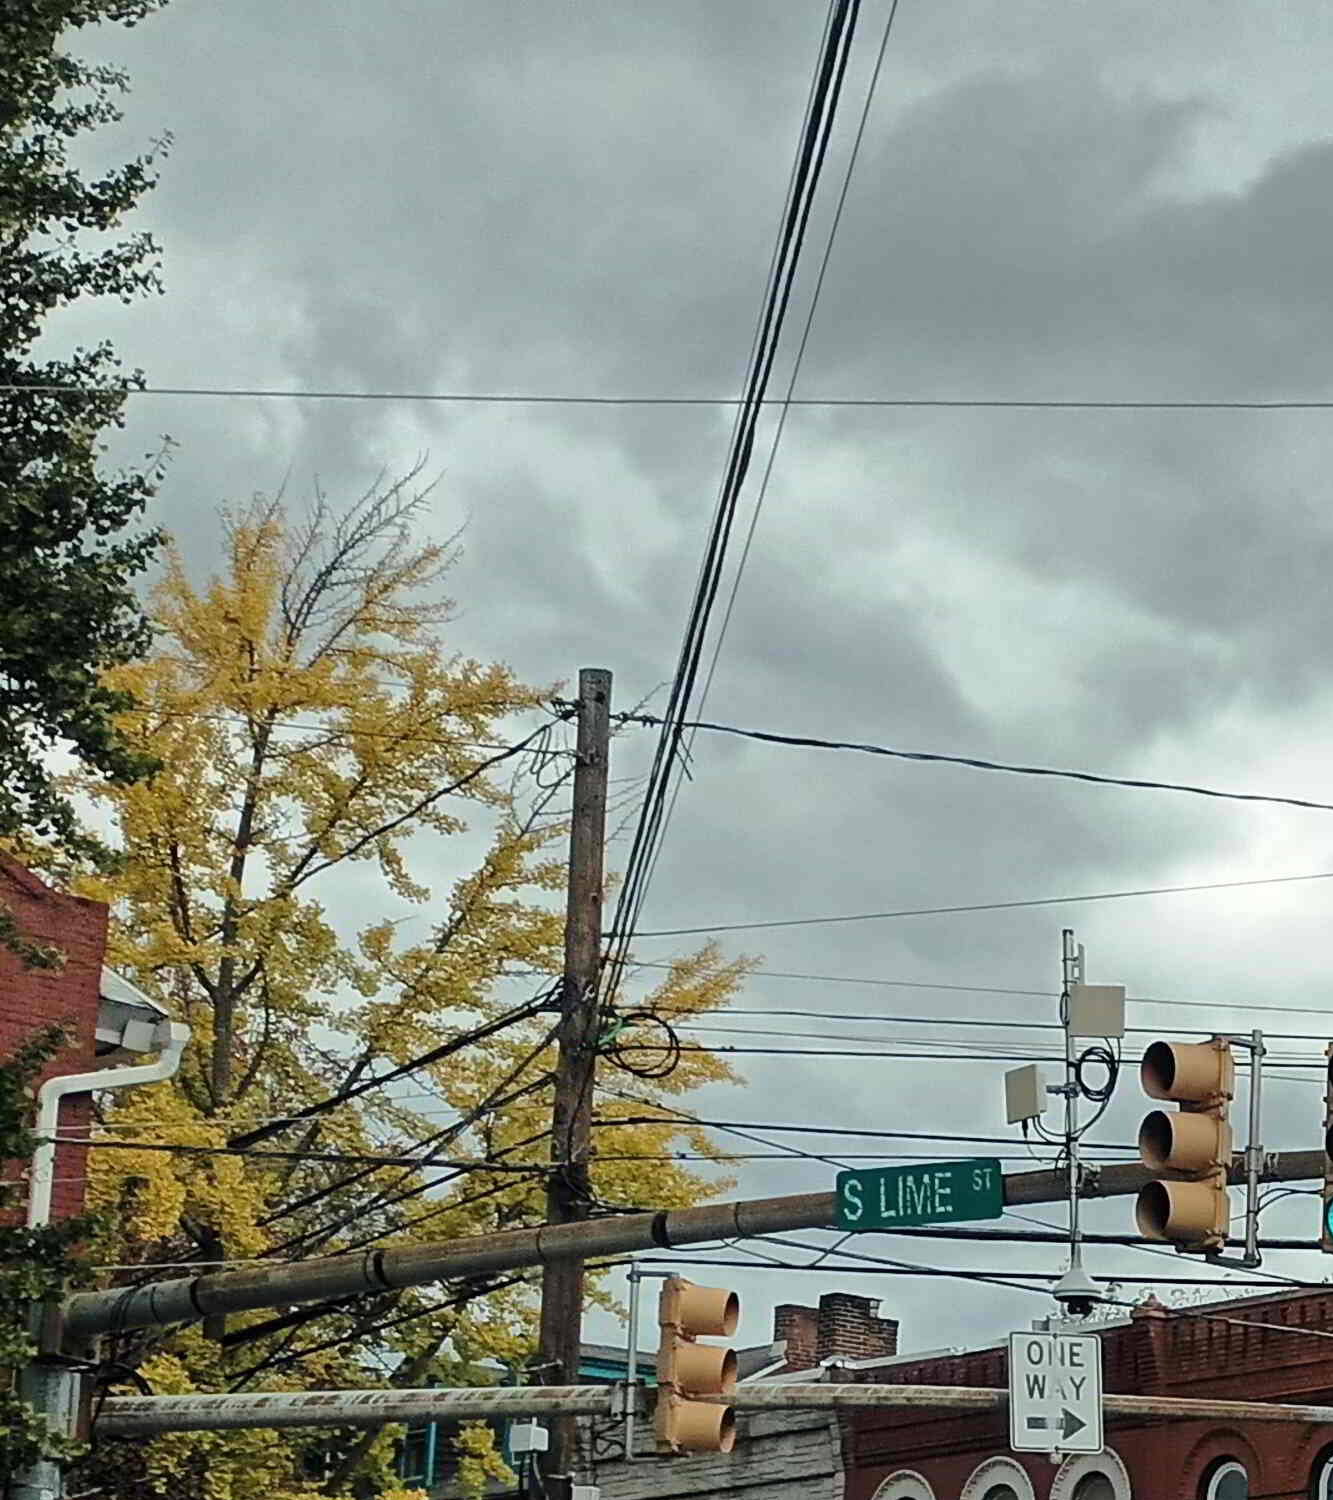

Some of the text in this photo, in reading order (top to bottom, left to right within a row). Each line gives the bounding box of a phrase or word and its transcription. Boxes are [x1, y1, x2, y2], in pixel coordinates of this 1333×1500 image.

[844, 1168, 993, 1221] S LIME ST
[1027, 1340, 1085, 1367] ONE
[1026, 1373, 1087, 1401] WAY
